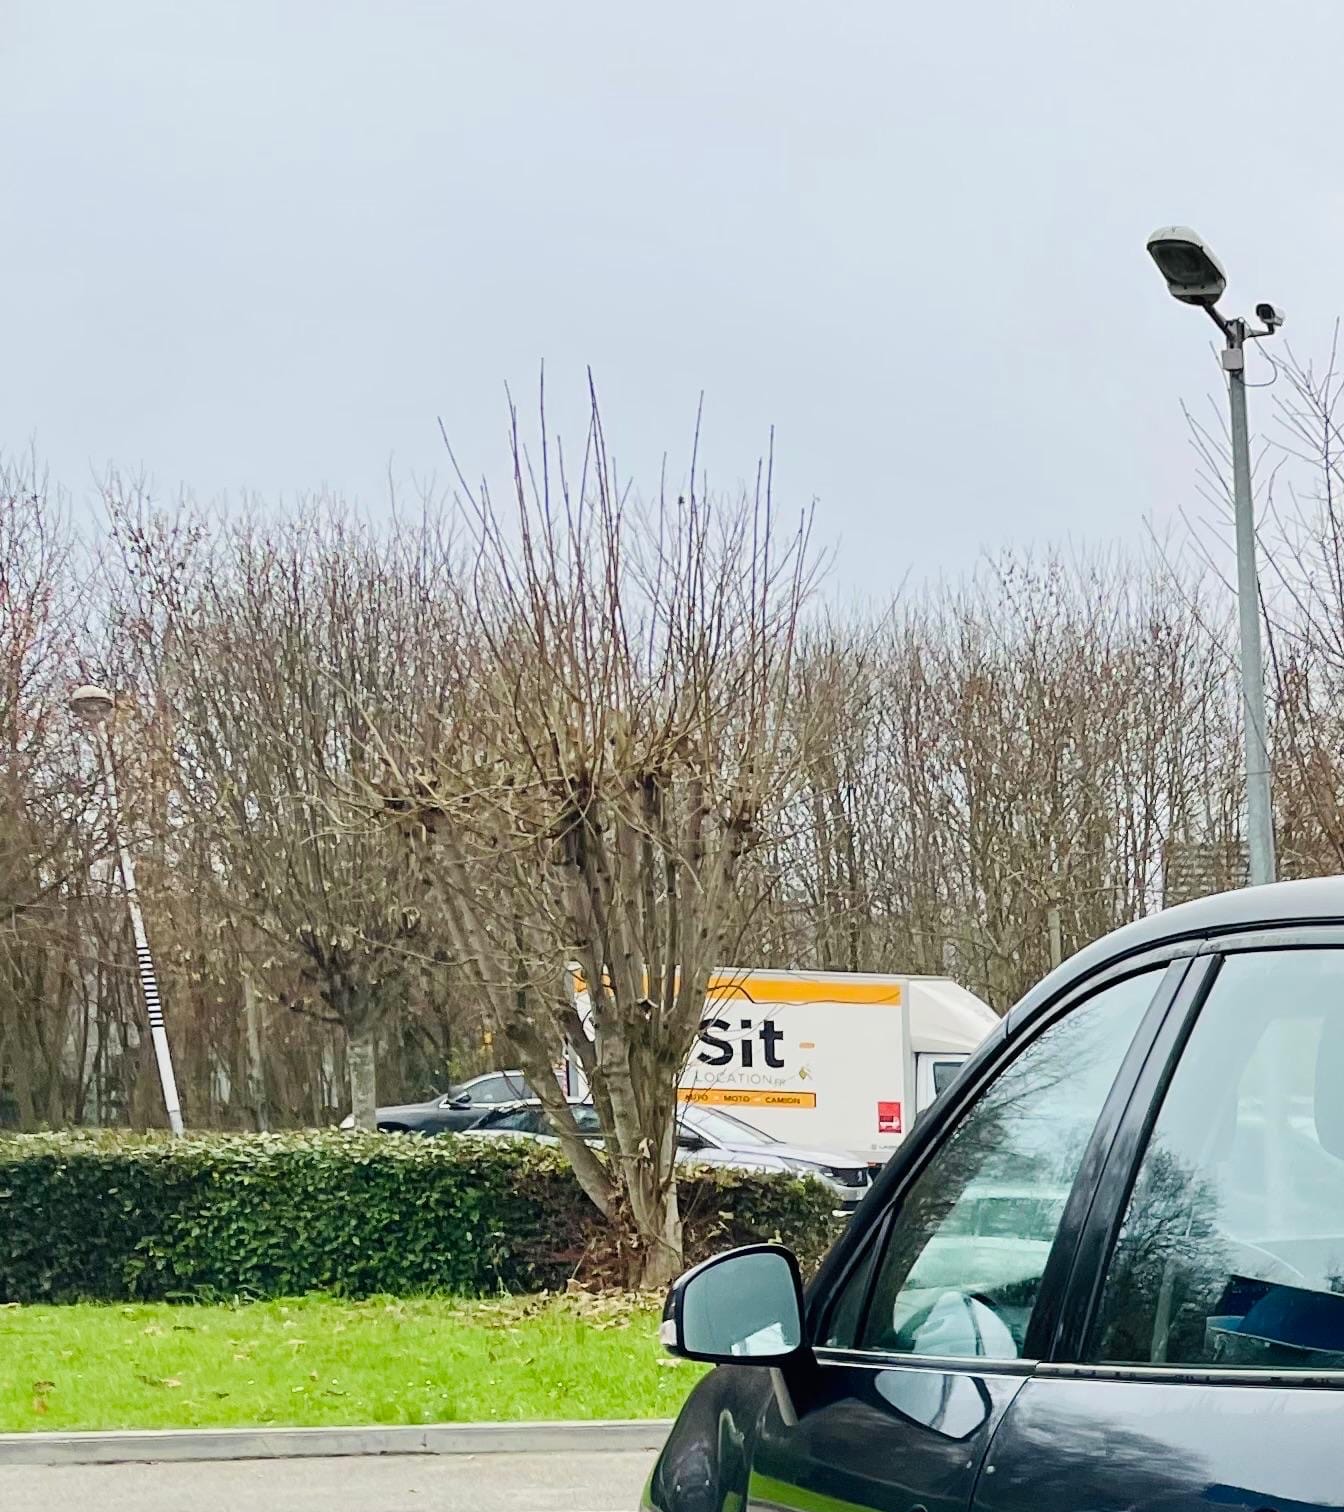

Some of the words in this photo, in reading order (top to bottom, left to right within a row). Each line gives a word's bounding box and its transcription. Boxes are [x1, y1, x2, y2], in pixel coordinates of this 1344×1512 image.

[697, 1018, 785, 1069] Sit
[723, 1095, 751, 1103] MOTO
[765, 1096, 801, 1105] CAMION
